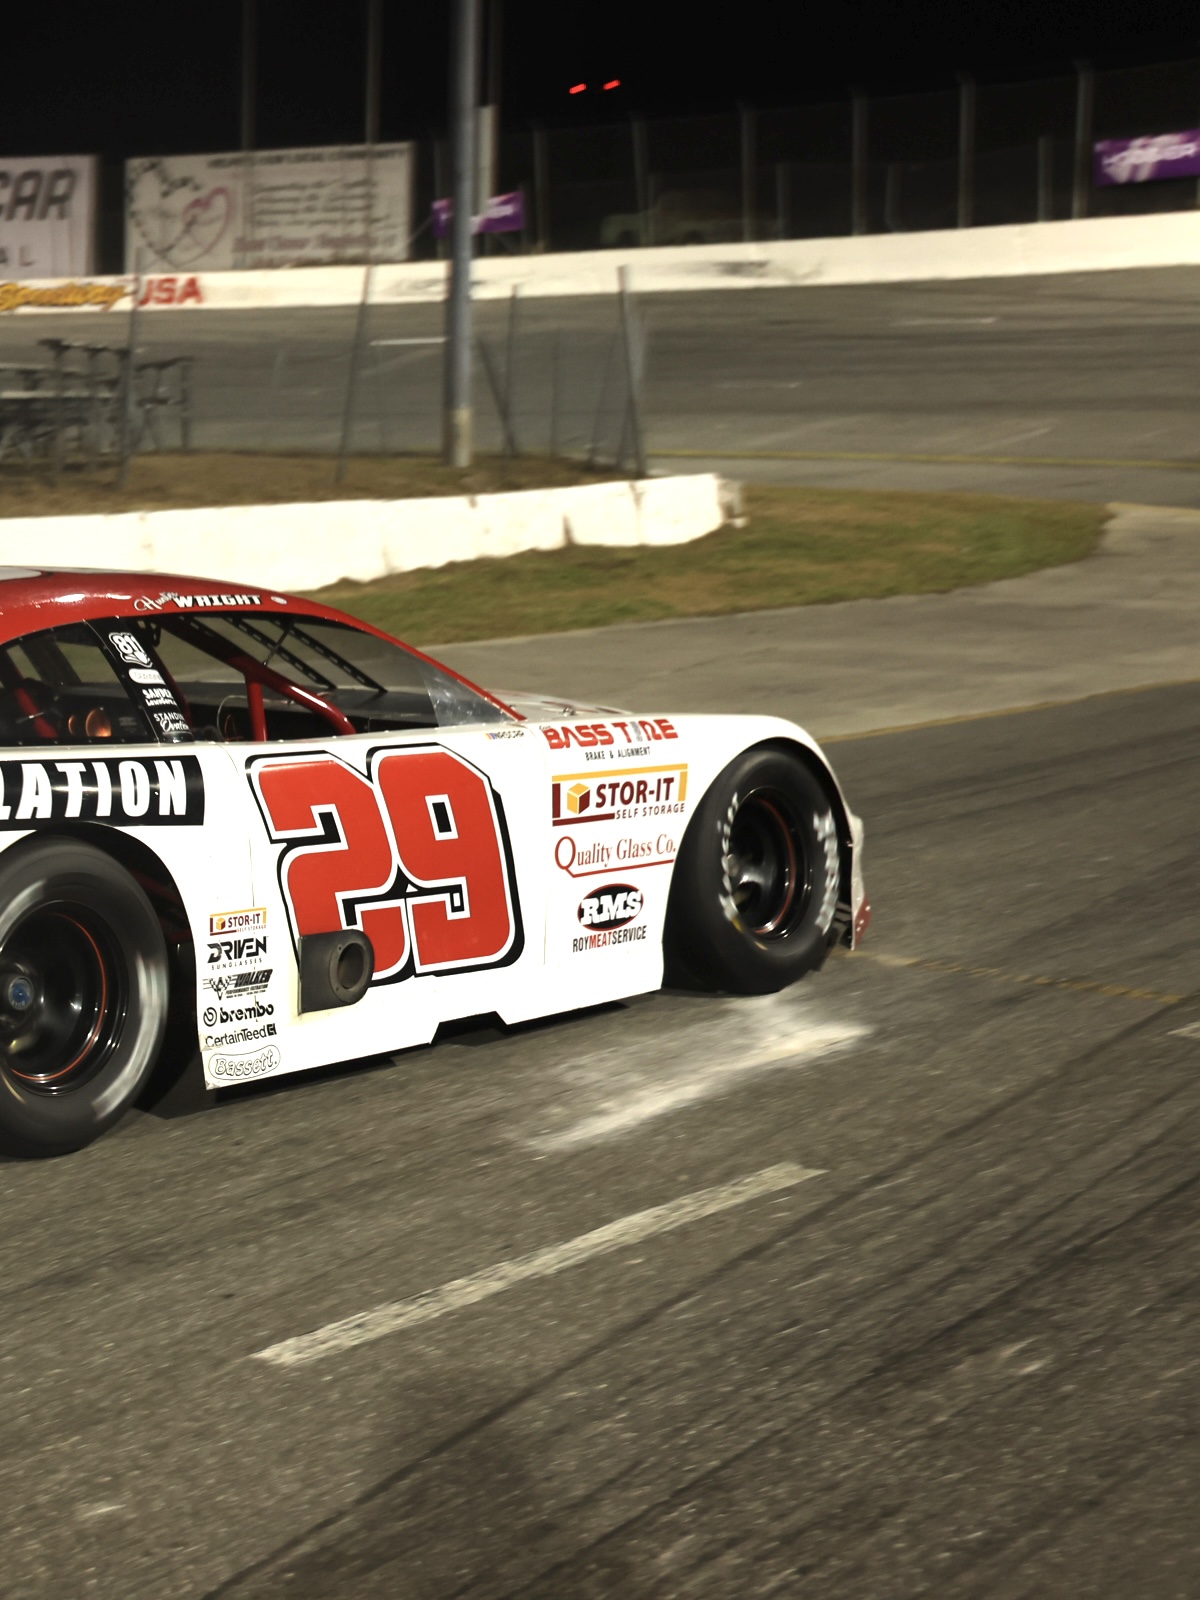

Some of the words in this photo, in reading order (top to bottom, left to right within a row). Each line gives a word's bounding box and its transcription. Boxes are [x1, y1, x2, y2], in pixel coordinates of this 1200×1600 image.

[174, 594, 261, 608] WRIGHT
[542, 723, 614, 749] BASS
[585, 750, 606, 761] BRAKE
[618, 746, 651, 758] ALIGNMENT
[595, 777, 675, 808] STOR-IT
[616, 809, 638, 820] SELF
[642, 802, 686, 816] STORAGE
[555, 836, 612, 871] Quality
[617, 838, 652, 860] Glass
[657, 834, 676, 854] Co.
[248, 745, 522, 985] 29
[579, 890, 643, 925] RMS
[228, 913, 261, 928] STOR-IT
[207, 936, 267, 963] DRIVEN
[211, 957, 262, 970] SUNGLASSES
[236, 969, 272, 987] WALKER
[220, 1001, 274, 1024] brembo
[205, 1026, 267, 1048] CertainTeed
